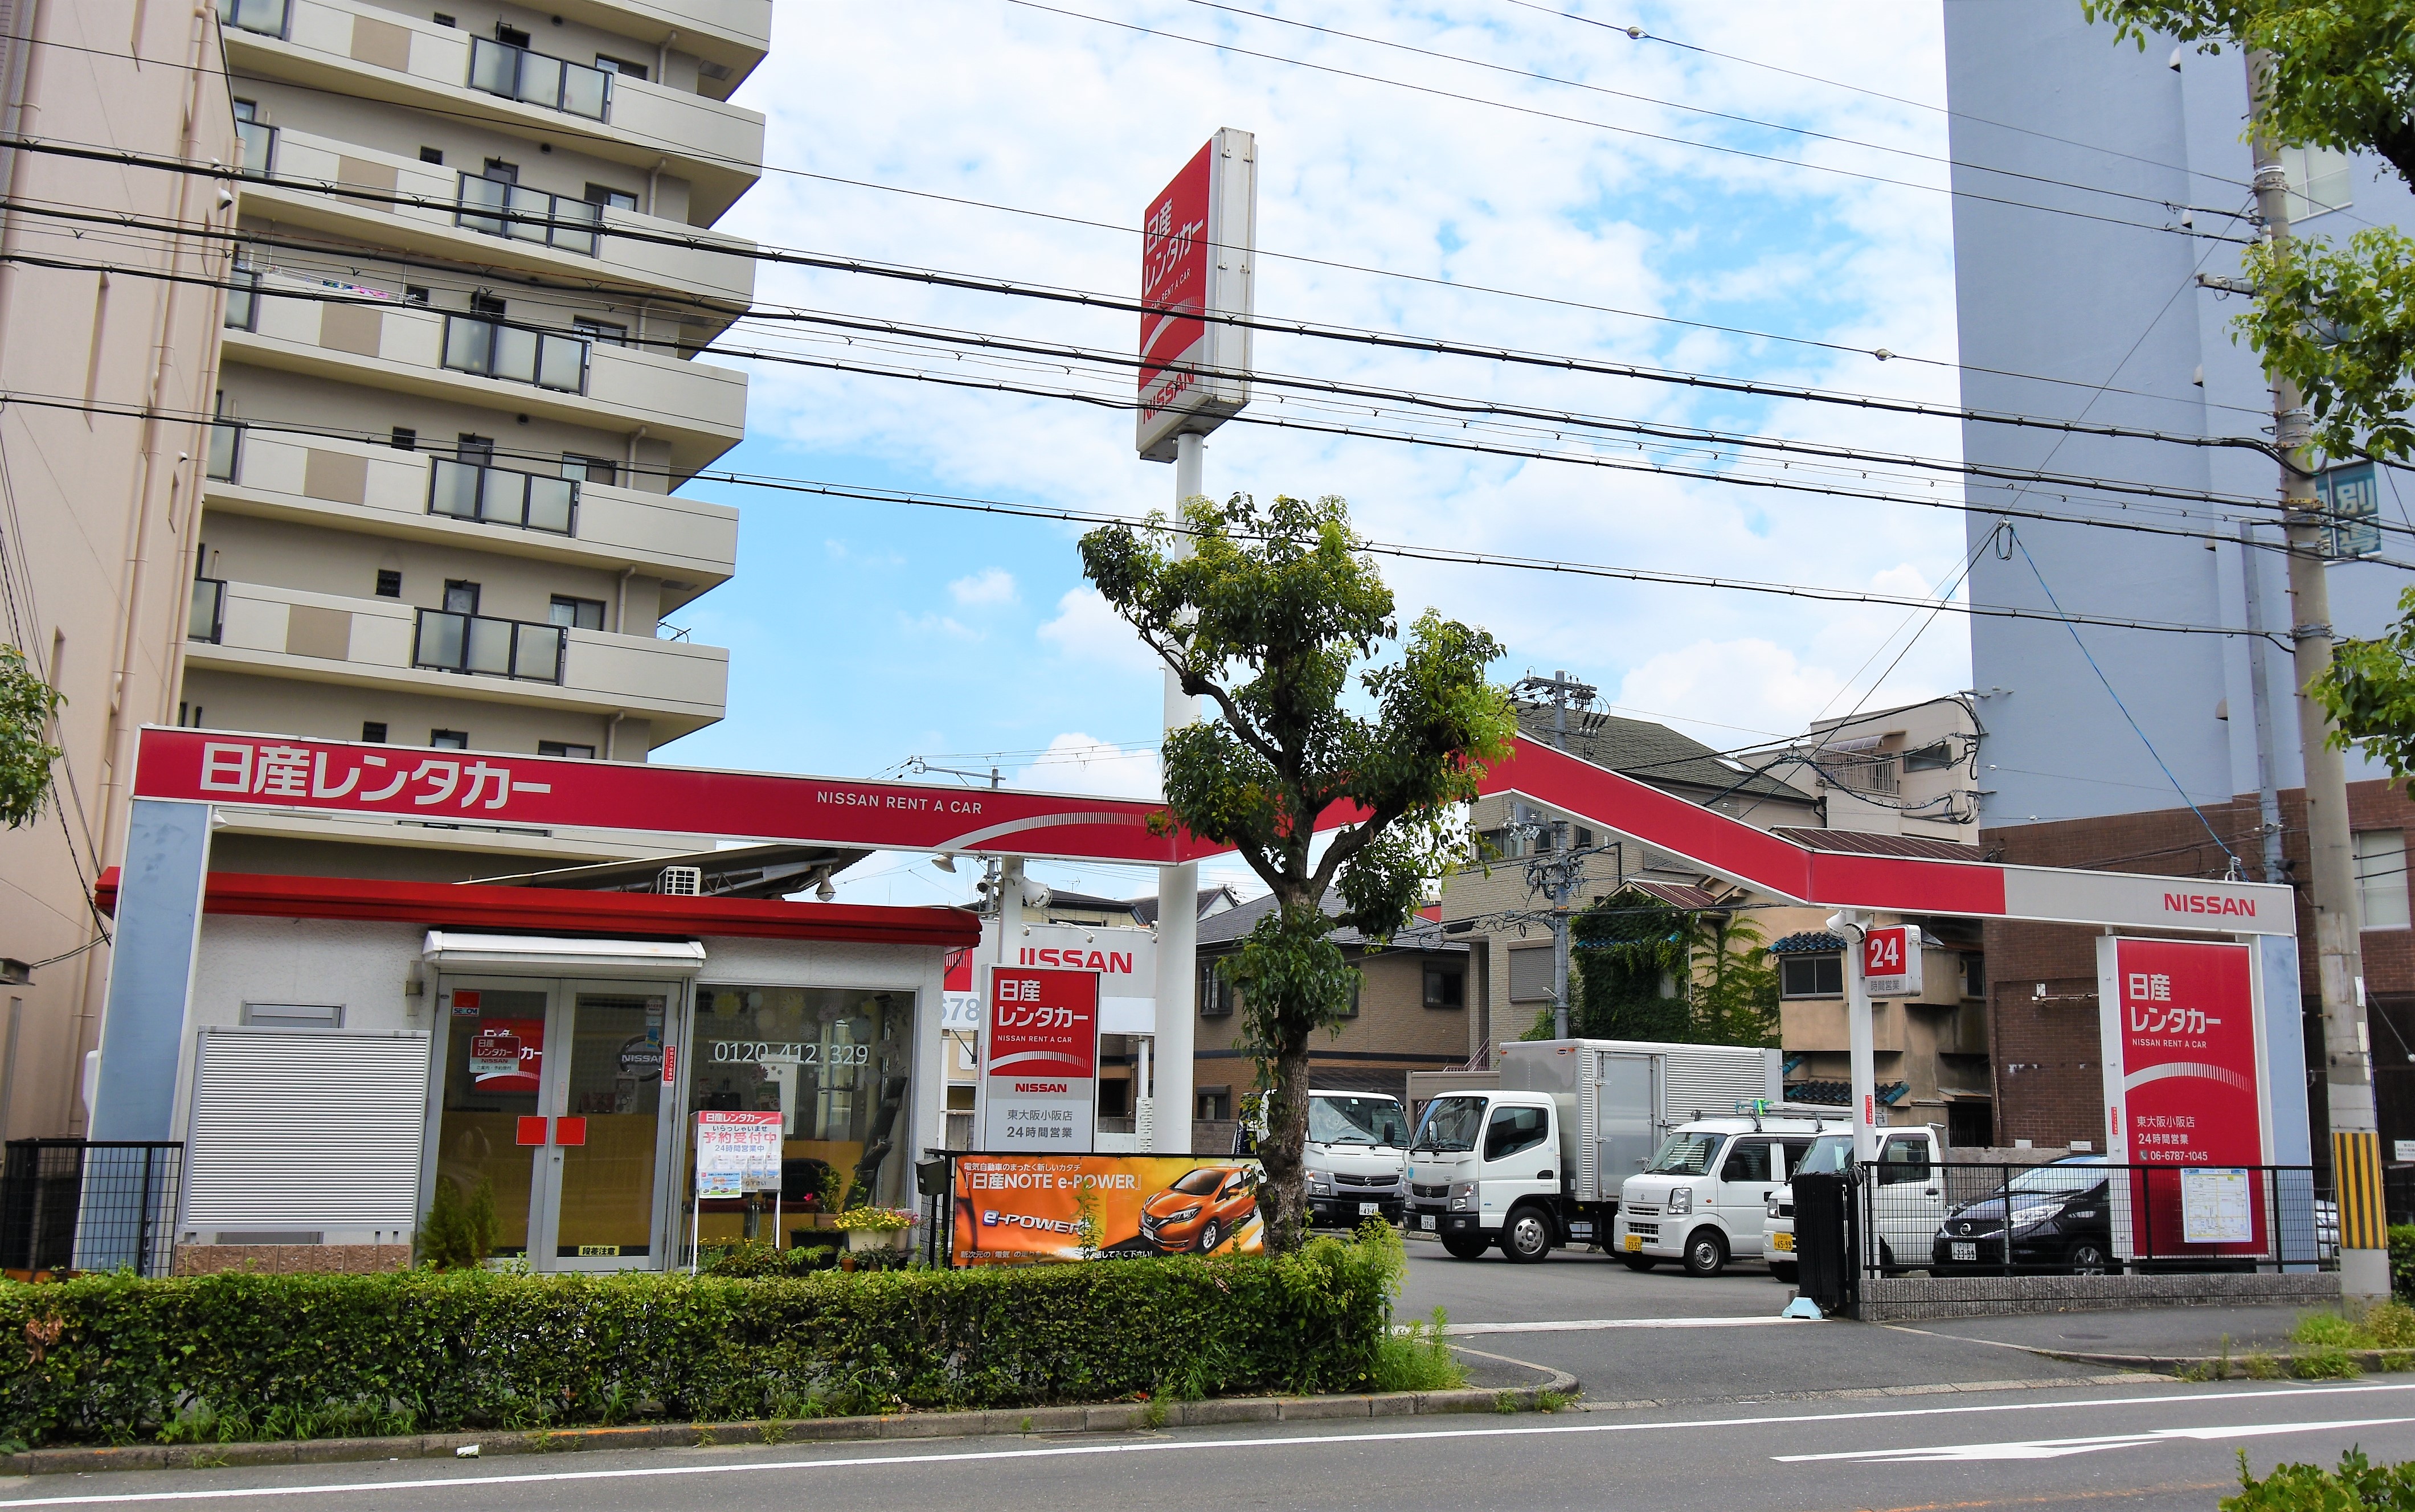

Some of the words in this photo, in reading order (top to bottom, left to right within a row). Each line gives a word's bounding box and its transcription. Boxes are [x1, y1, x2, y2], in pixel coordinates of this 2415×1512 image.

[1145, 197, 1173, 255] 日産
[1144, 218, 1204, 297] レンタカー
[1161, 283, 1174, 303] RENT
[1174, 279, 1178, 290] A
[1180, 268, 1191, 284] CAR
[1143, 361, 1195, 425] NISSAN
[199, 741, 552, 810] 日産レンタカー
[817, 791, 879, 808] NISSAN
[886, 795, 928, 812] RENT
[934, 800, 944, 813] A
[949, 800, 983, 815] CAR
[2164, 892, 2256, 917] NISSAN
[1869, 937, 1900, 968] 24
[999, 979, 1041, 1002] 日産
[1870, 979, 1900, 991] 時間営業
[2129, 973, 2171, 1001] 日産
[942, 997, 980, 1022] 78
[998, 1006, 1088, 1029] レンタカー
[2130, 1006, 2221, 1034] レンタカー
[2132, 1038, 2160, 1047] NISSAN
[1015, 1083, 1067, 1093] NISSAN
[706, 1113, 762, 1122] 日産レンタカー
[1007, 1109, 1073, 1121] 東大阪小阪店
[2136, 1116, 2195, 1128] 東大阪小阪店
[703, 1132, 777, 1145] 予約受付中
[1006, 1126, 1073, 1138] 24時間営業
[2138, 1133, 2189, 1145] 24時間営業
[2150, 1150, 2208, 1161] 06-6787-1045
[964, 1162, 1081, 1172] 電気自動車のまったく新しいカタチ
[1628, 1241, 1640, 1250] 23-53
[1777, 1240, 1791, 1249] 65-99
[582, 1247, 616, 1256] 段差注意
